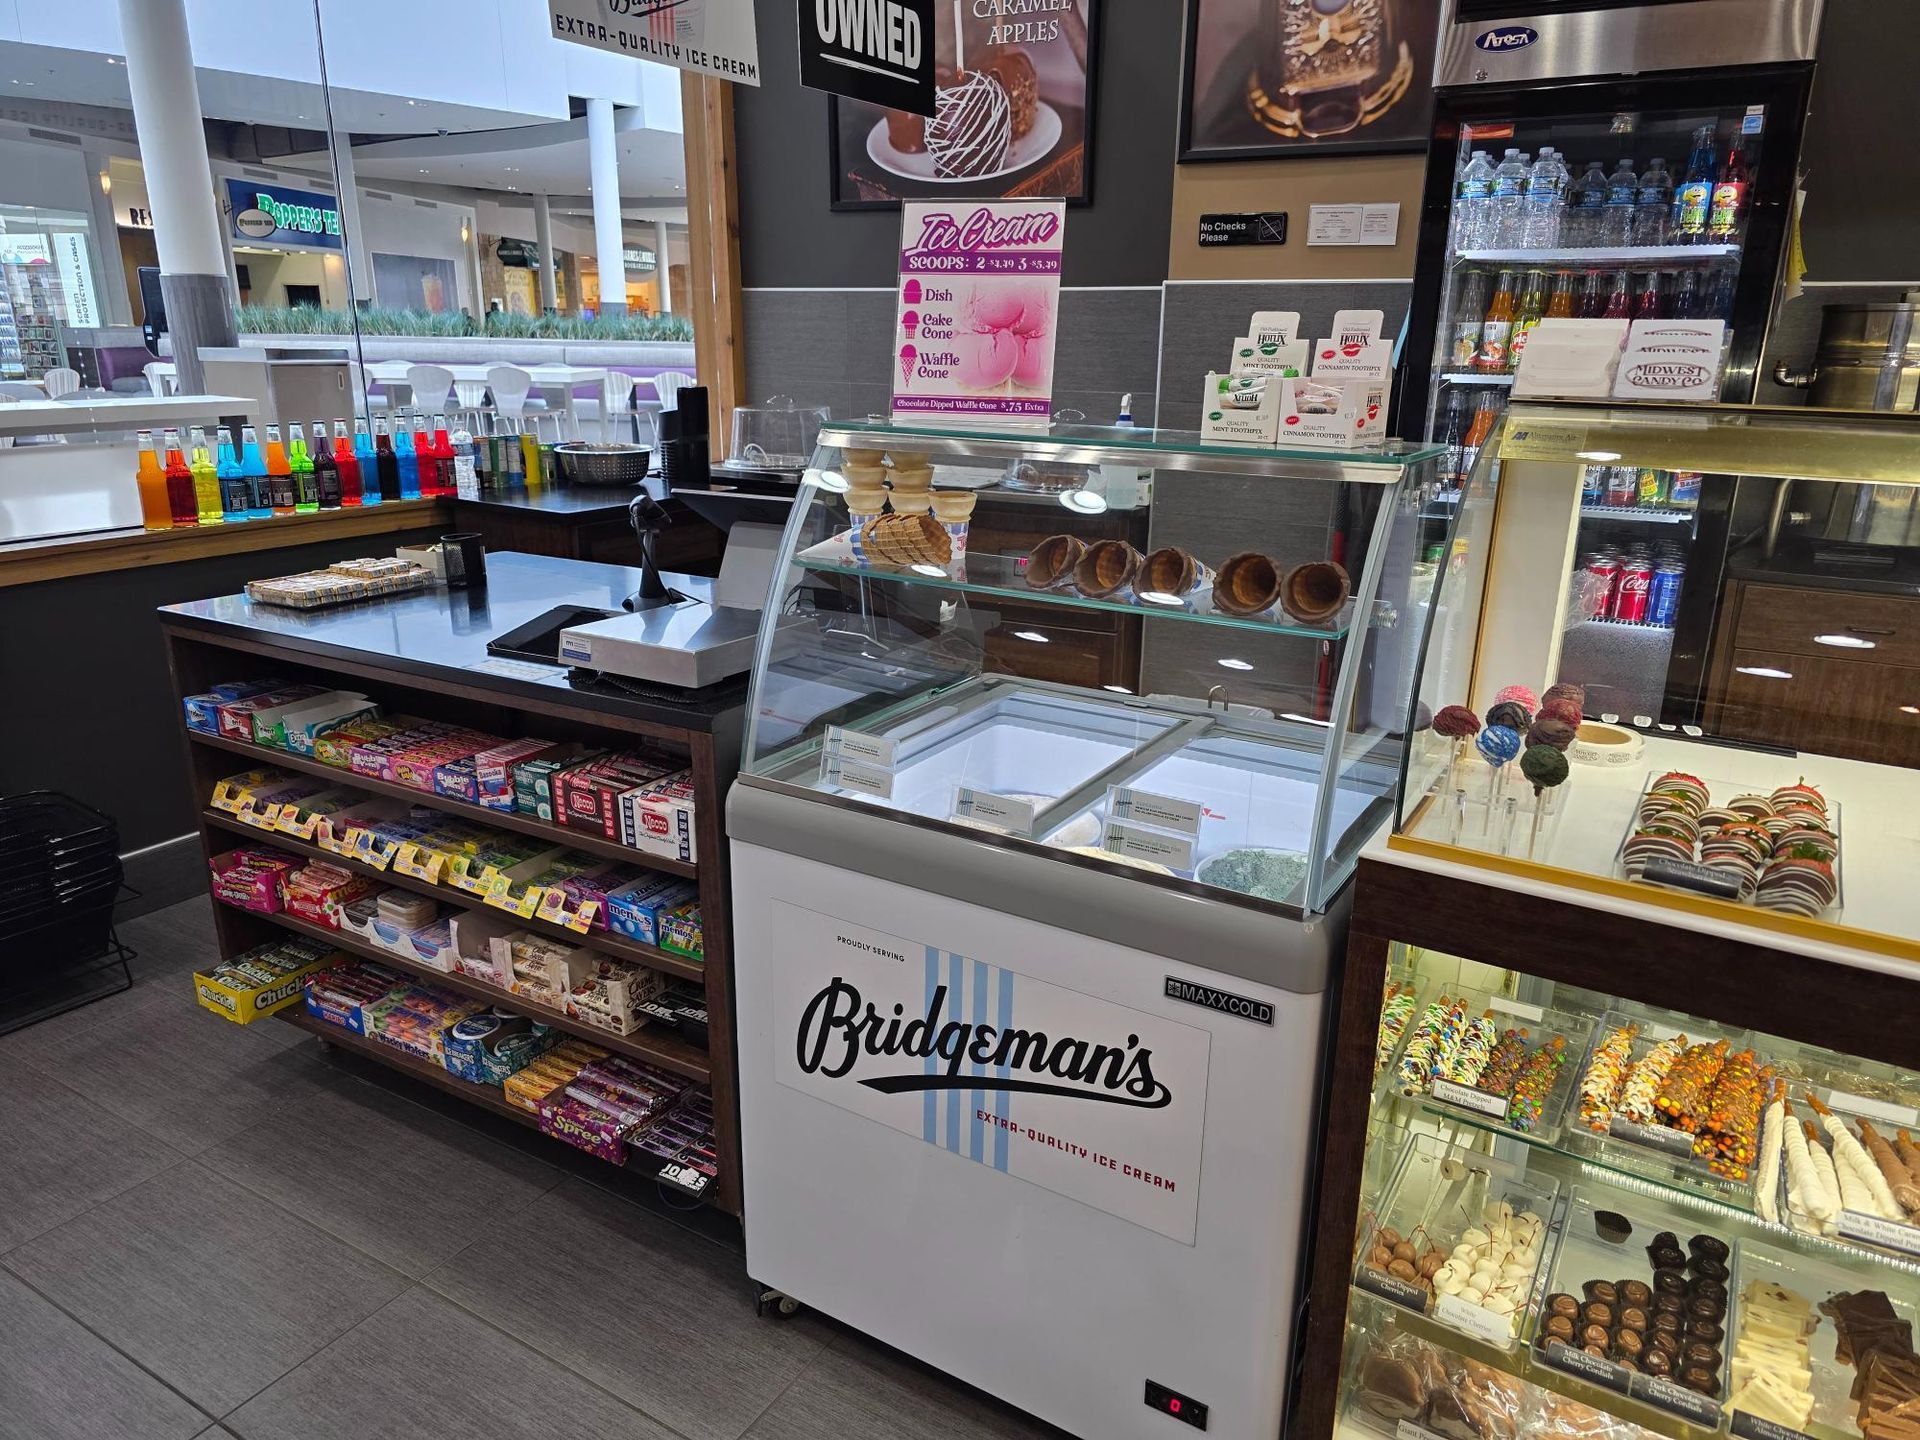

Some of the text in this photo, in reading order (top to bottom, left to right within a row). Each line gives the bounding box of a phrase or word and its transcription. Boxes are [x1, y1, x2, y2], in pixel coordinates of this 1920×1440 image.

[973, 0, 1072, 18] CARAMEL
[816, 0, 922, 70] OWNED
[987, 19, 1059, 46] APPLES
[556, 14, 681, 60] EXTRA-QUALITY
[686, 48, 708, 67] ICE
[713, 55, 756, 79] CREAM
[256, 193, 323, 233] POPPER'S
[905, 208, 1059, 256] Ice Cream
[1201, 221, 1247, 231] No Checks
[1200, 234, 1229, 242] Please
[909, 256, 970, 270] SCOOPS:
[975, 256, 986, 270] 2
[1017, 257, 1027, 271] 3
[925, 289, 953, 302] Dish
[922, 314, 953, 326] Cake
[921, 327, 953, 339] Cone
[919, 352, 960, 366] Waffle
[917, 366, 949, 378] Cone
[1634, 364, 1705, 377] MIDWEST
[1633, 376, 1680, 386] CANDY
[897, 399, 929, 408] Chocolate
[930, 400, 954, 410] Dipped
[955, 400, 978, 409] Waffle
[979, 402, 997, 410] Cone
[1024, 403, 1044, 412] Extra
[437, 772, 470, 784] Bubble
[573, 795, 594, 810] Necco
[645, 814, 667, 832] Necco
[1658, 859, 1726, 880] Chocolate Dipped
[661, 925, 693, 940] mentos
[837, 935, 905, 962] PROUDLY SERVING
[236, 962, 277, 984] Chuckles
[1181, 984, 1271, 1023] MAXXCOLD
[796, 976, 1172, 1109] Bridgeman's
[1441, 1084, 1492, 1104] Chocolate Dipped
[1443, 1093, 1485, 1111] M&M Pretzels
[553, 1115, 601, 1144] Spree
[1639, 1129, 1666, 1143] Pretzels
[976, 1109, 1176, 1193] EXTRA-QUALITY ICE CREAM
[1368, 1271, 1419, 1296] Chocolate Dipped
[1380, 1283, 1405, 1297] Cherries
[1441, 1307, 1492, 1333] Chocolate Cherries
[1562, 1356, 1614, 1380] Cherry Cordials
[1564, 1349, 1613, 1372] Milk Chocolate
[1648, 1387, 1702, 1414] Cherry Cordials
[1650, 1380, 1702, 1403] Dark Chocolate
[1398, 1424, 1418, 1439] Giant
[1750, 1416, 1771, 1430] White
